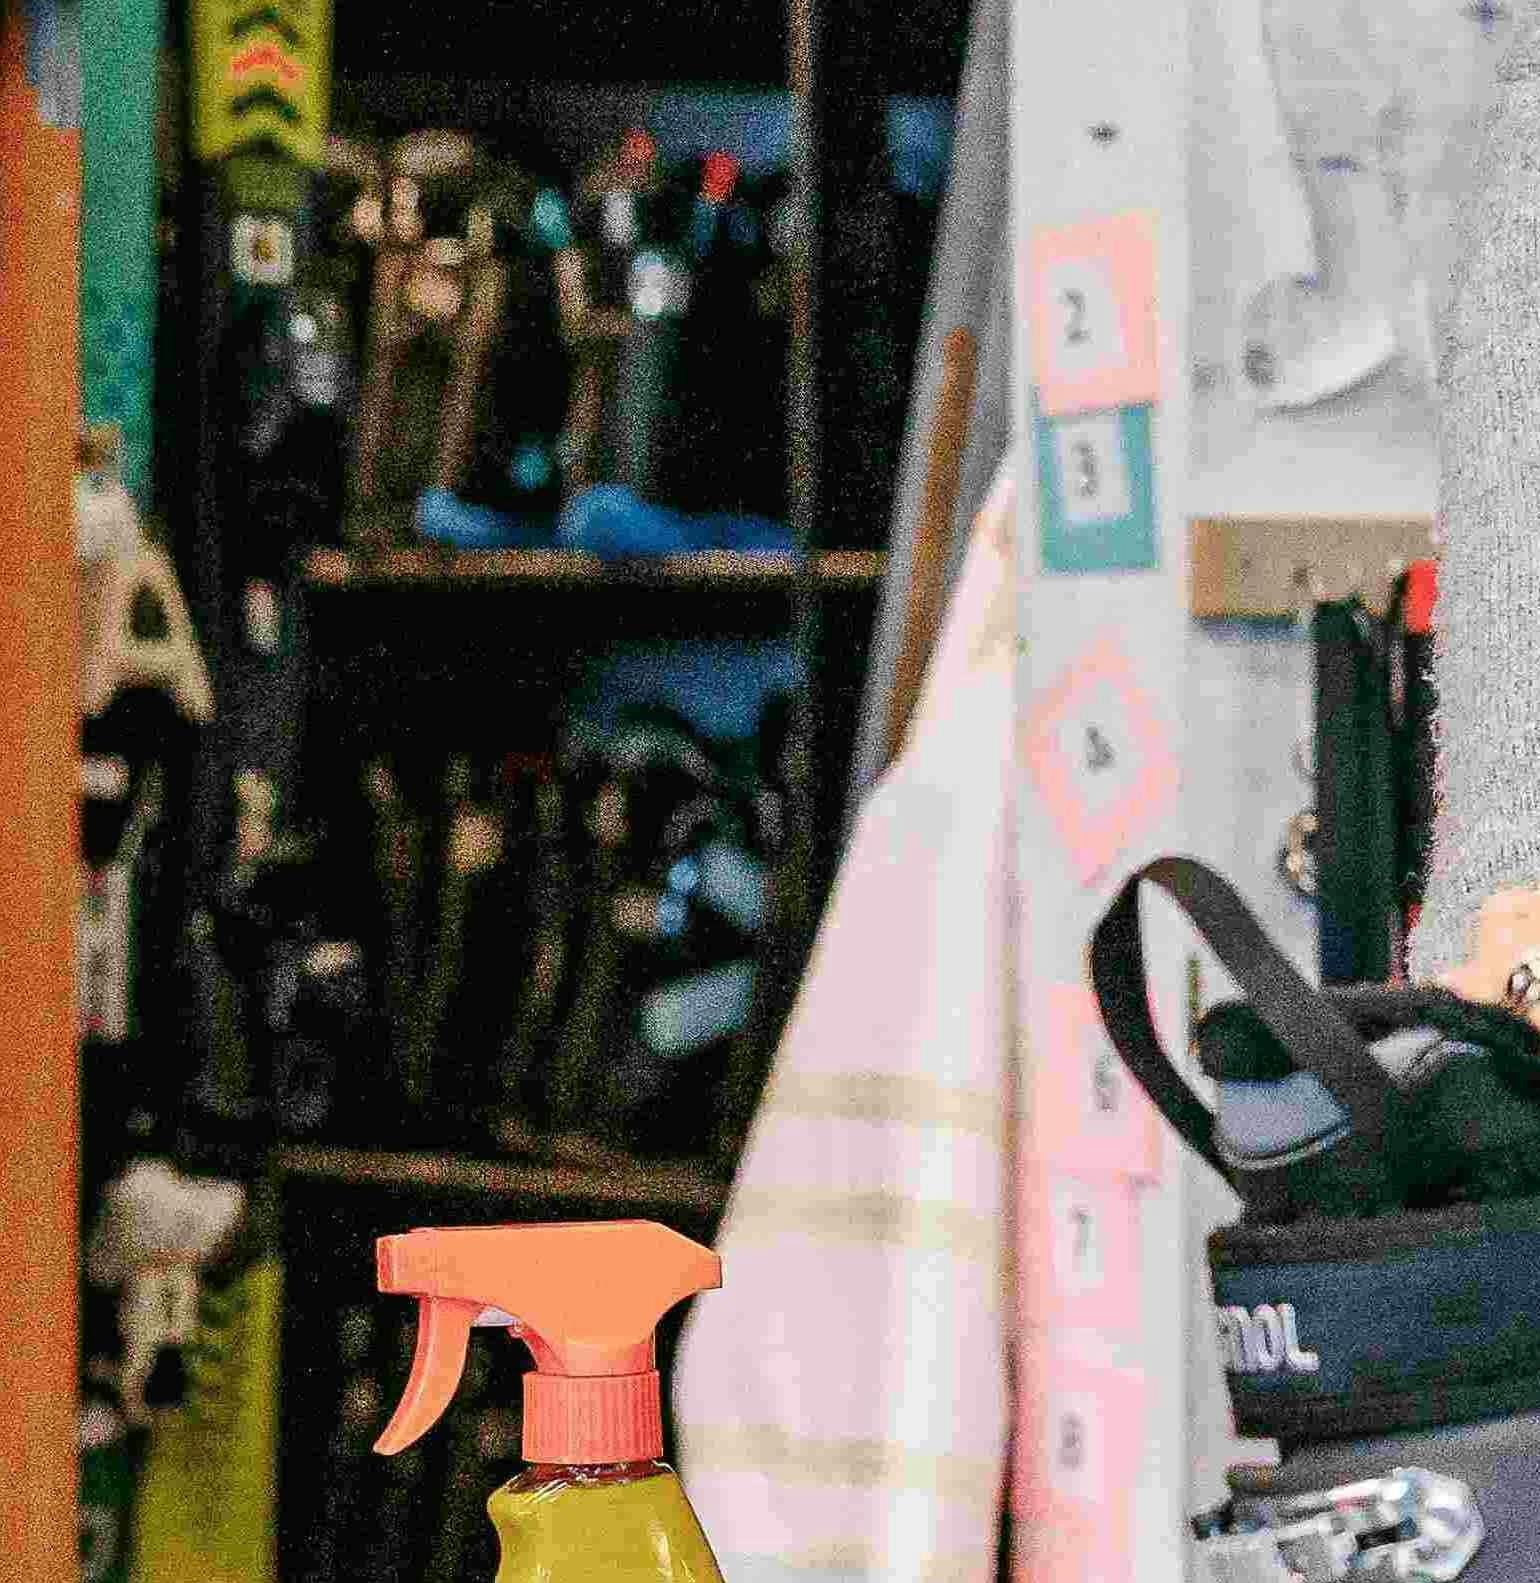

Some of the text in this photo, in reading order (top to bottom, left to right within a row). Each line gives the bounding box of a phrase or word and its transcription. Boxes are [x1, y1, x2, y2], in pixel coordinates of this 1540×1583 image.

[1064, 288, 1089, 345] 2
[1074, 439, 1100, 498] 3
[1086, 724, 1114, 774] 4
